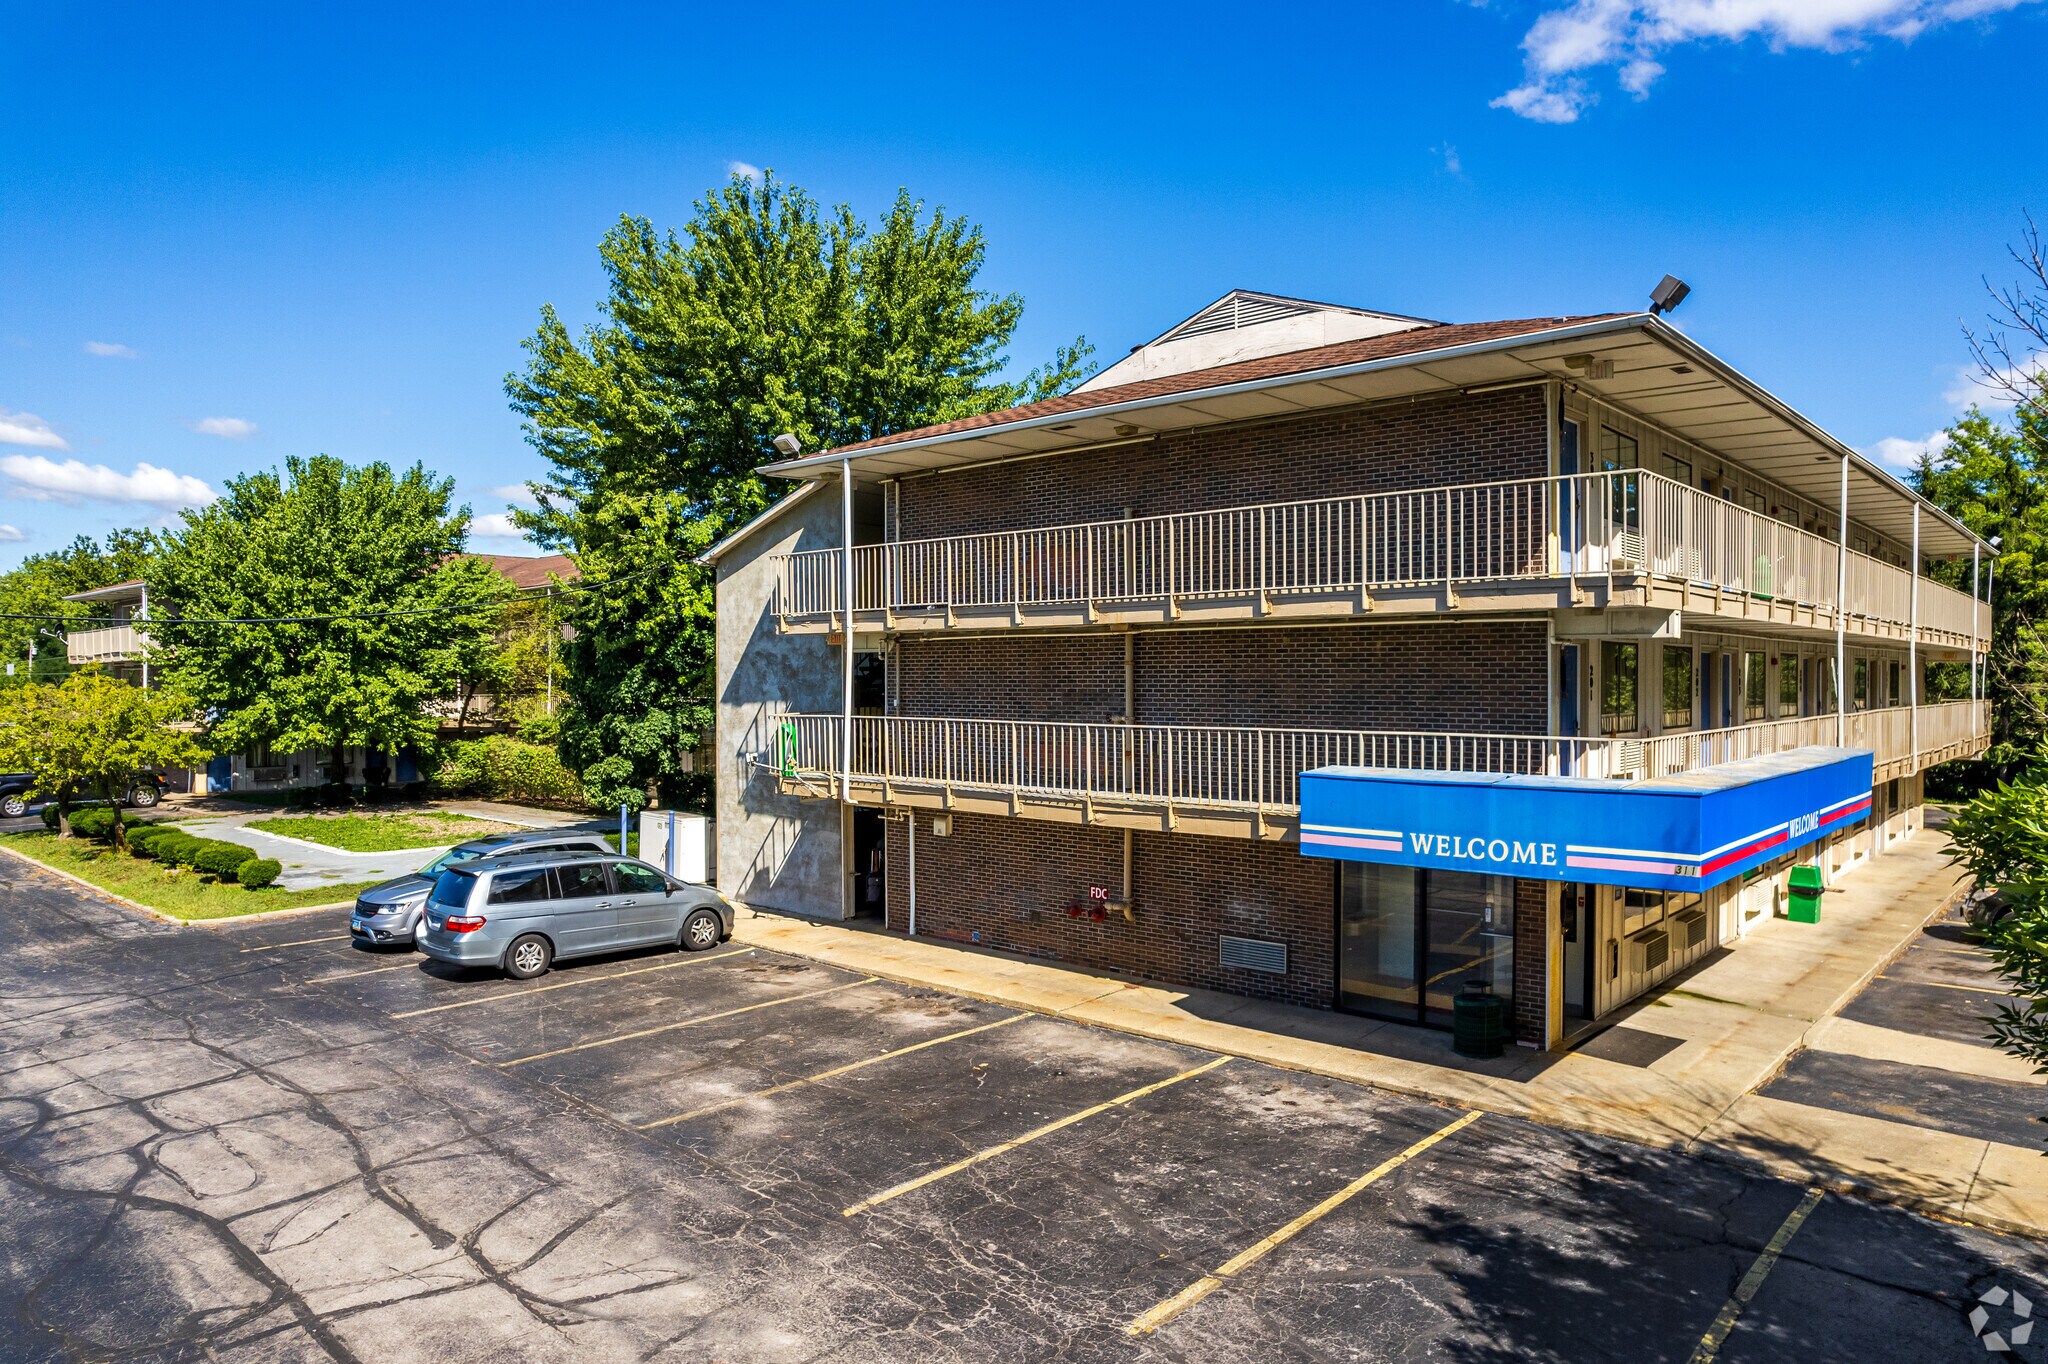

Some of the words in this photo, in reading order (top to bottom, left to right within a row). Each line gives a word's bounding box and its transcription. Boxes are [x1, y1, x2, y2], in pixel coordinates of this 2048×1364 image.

[1790, 810, 1819, 839] WELCOME
[1409, 832, 1557, 866] WELCOME
[1675, 865, 1696, 876] 311
[1090, 886, 1108, 899] FDC
